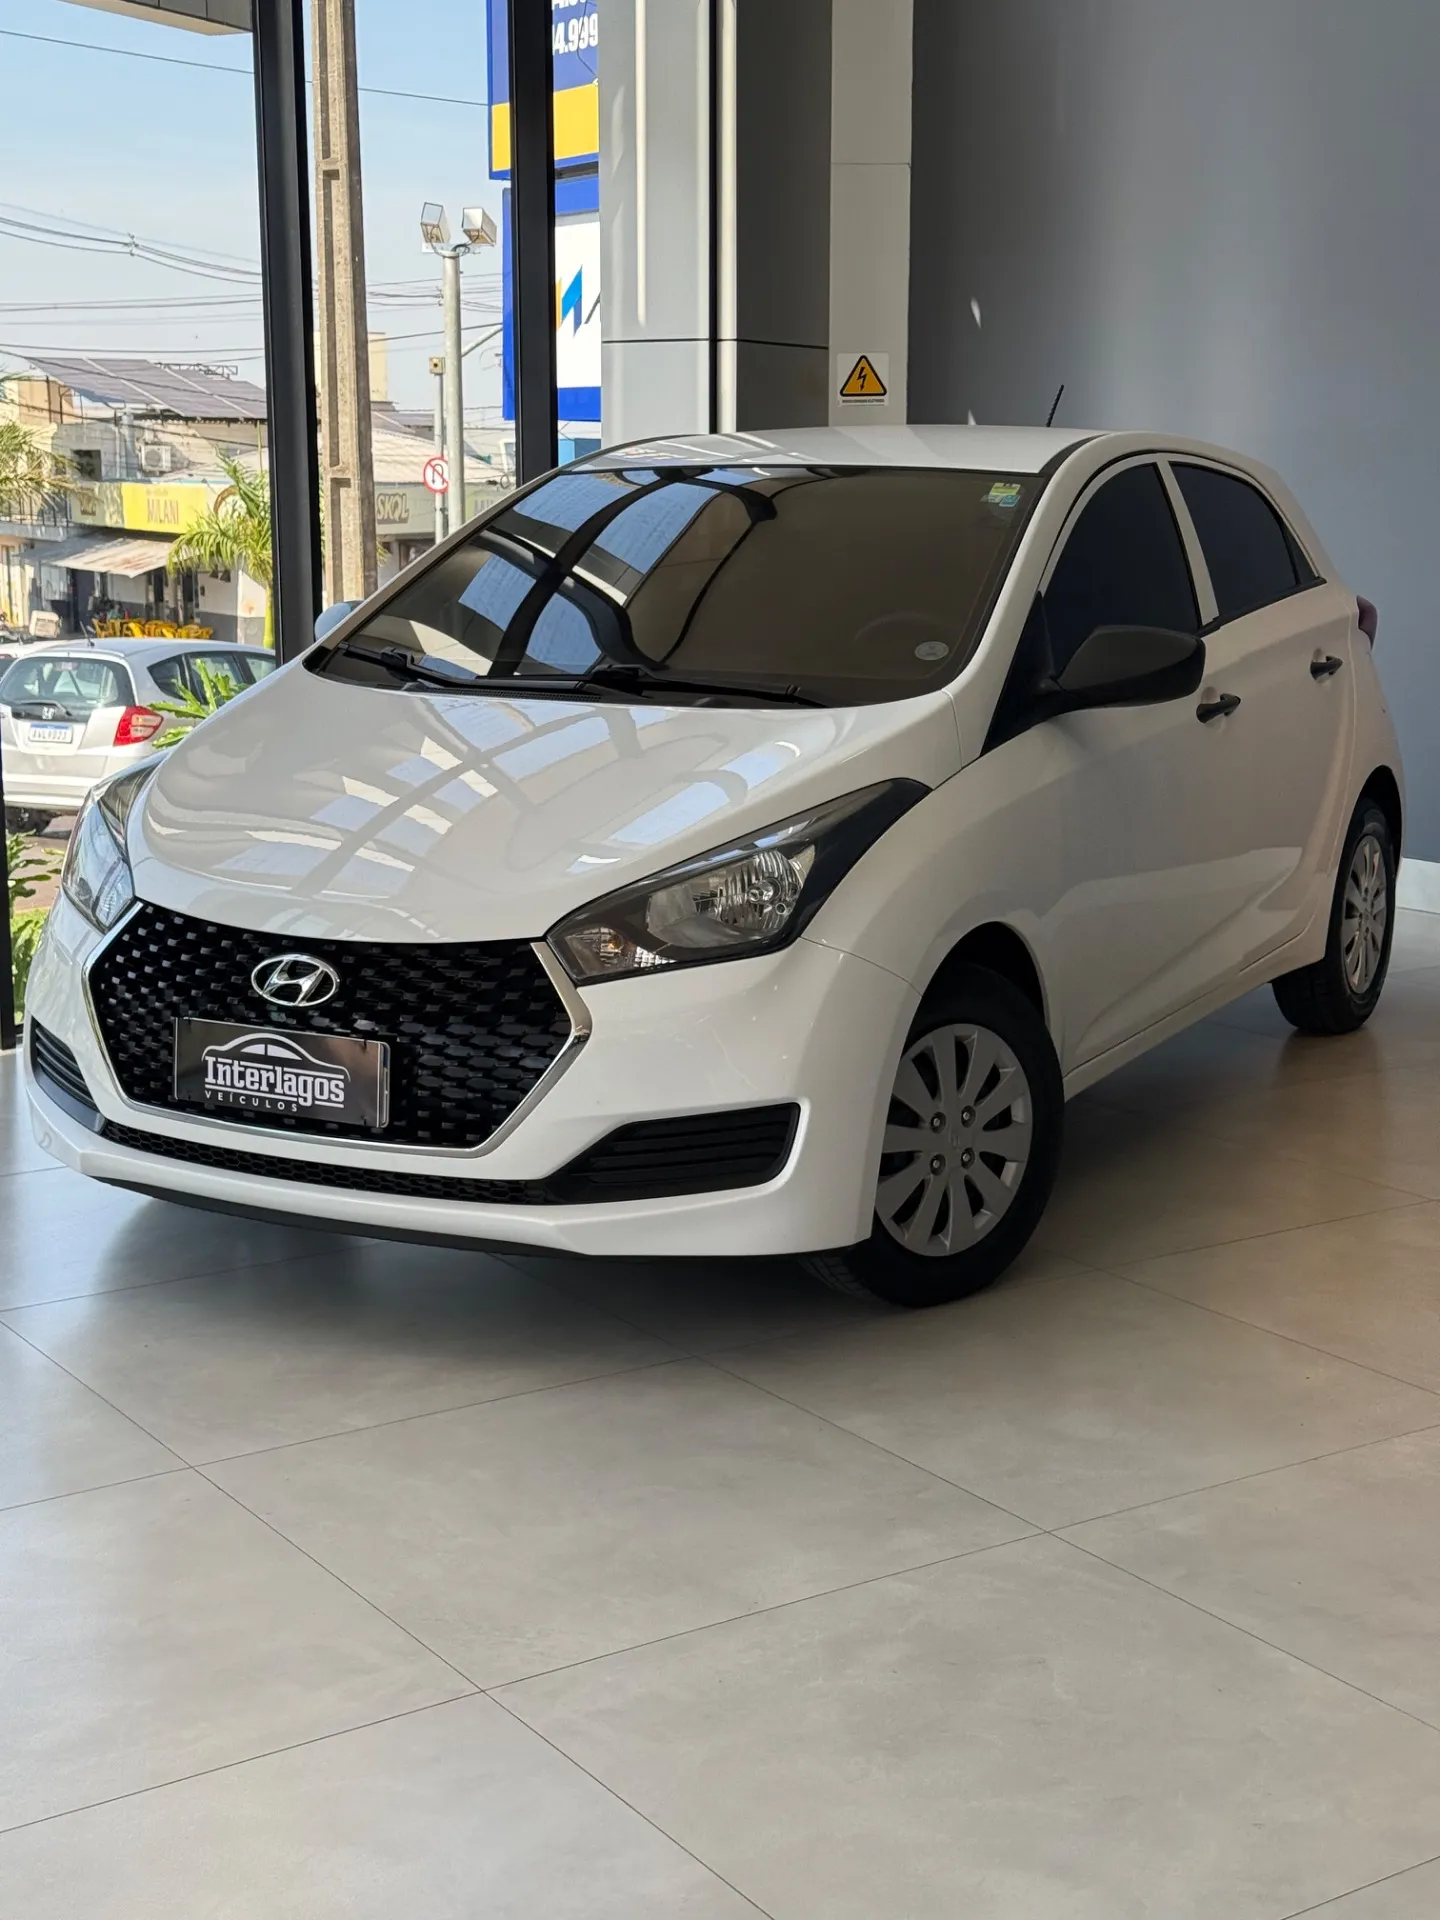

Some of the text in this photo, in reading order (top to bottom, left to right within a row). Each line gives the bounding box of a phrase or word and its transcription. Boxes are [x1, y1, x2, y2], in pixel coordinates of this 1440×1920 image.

[377, 493, 409, 521] SKOL
[205, 1056, 345, 1107] Interlagos
[205, 1090, 298, 1112] VEÍCULOS
